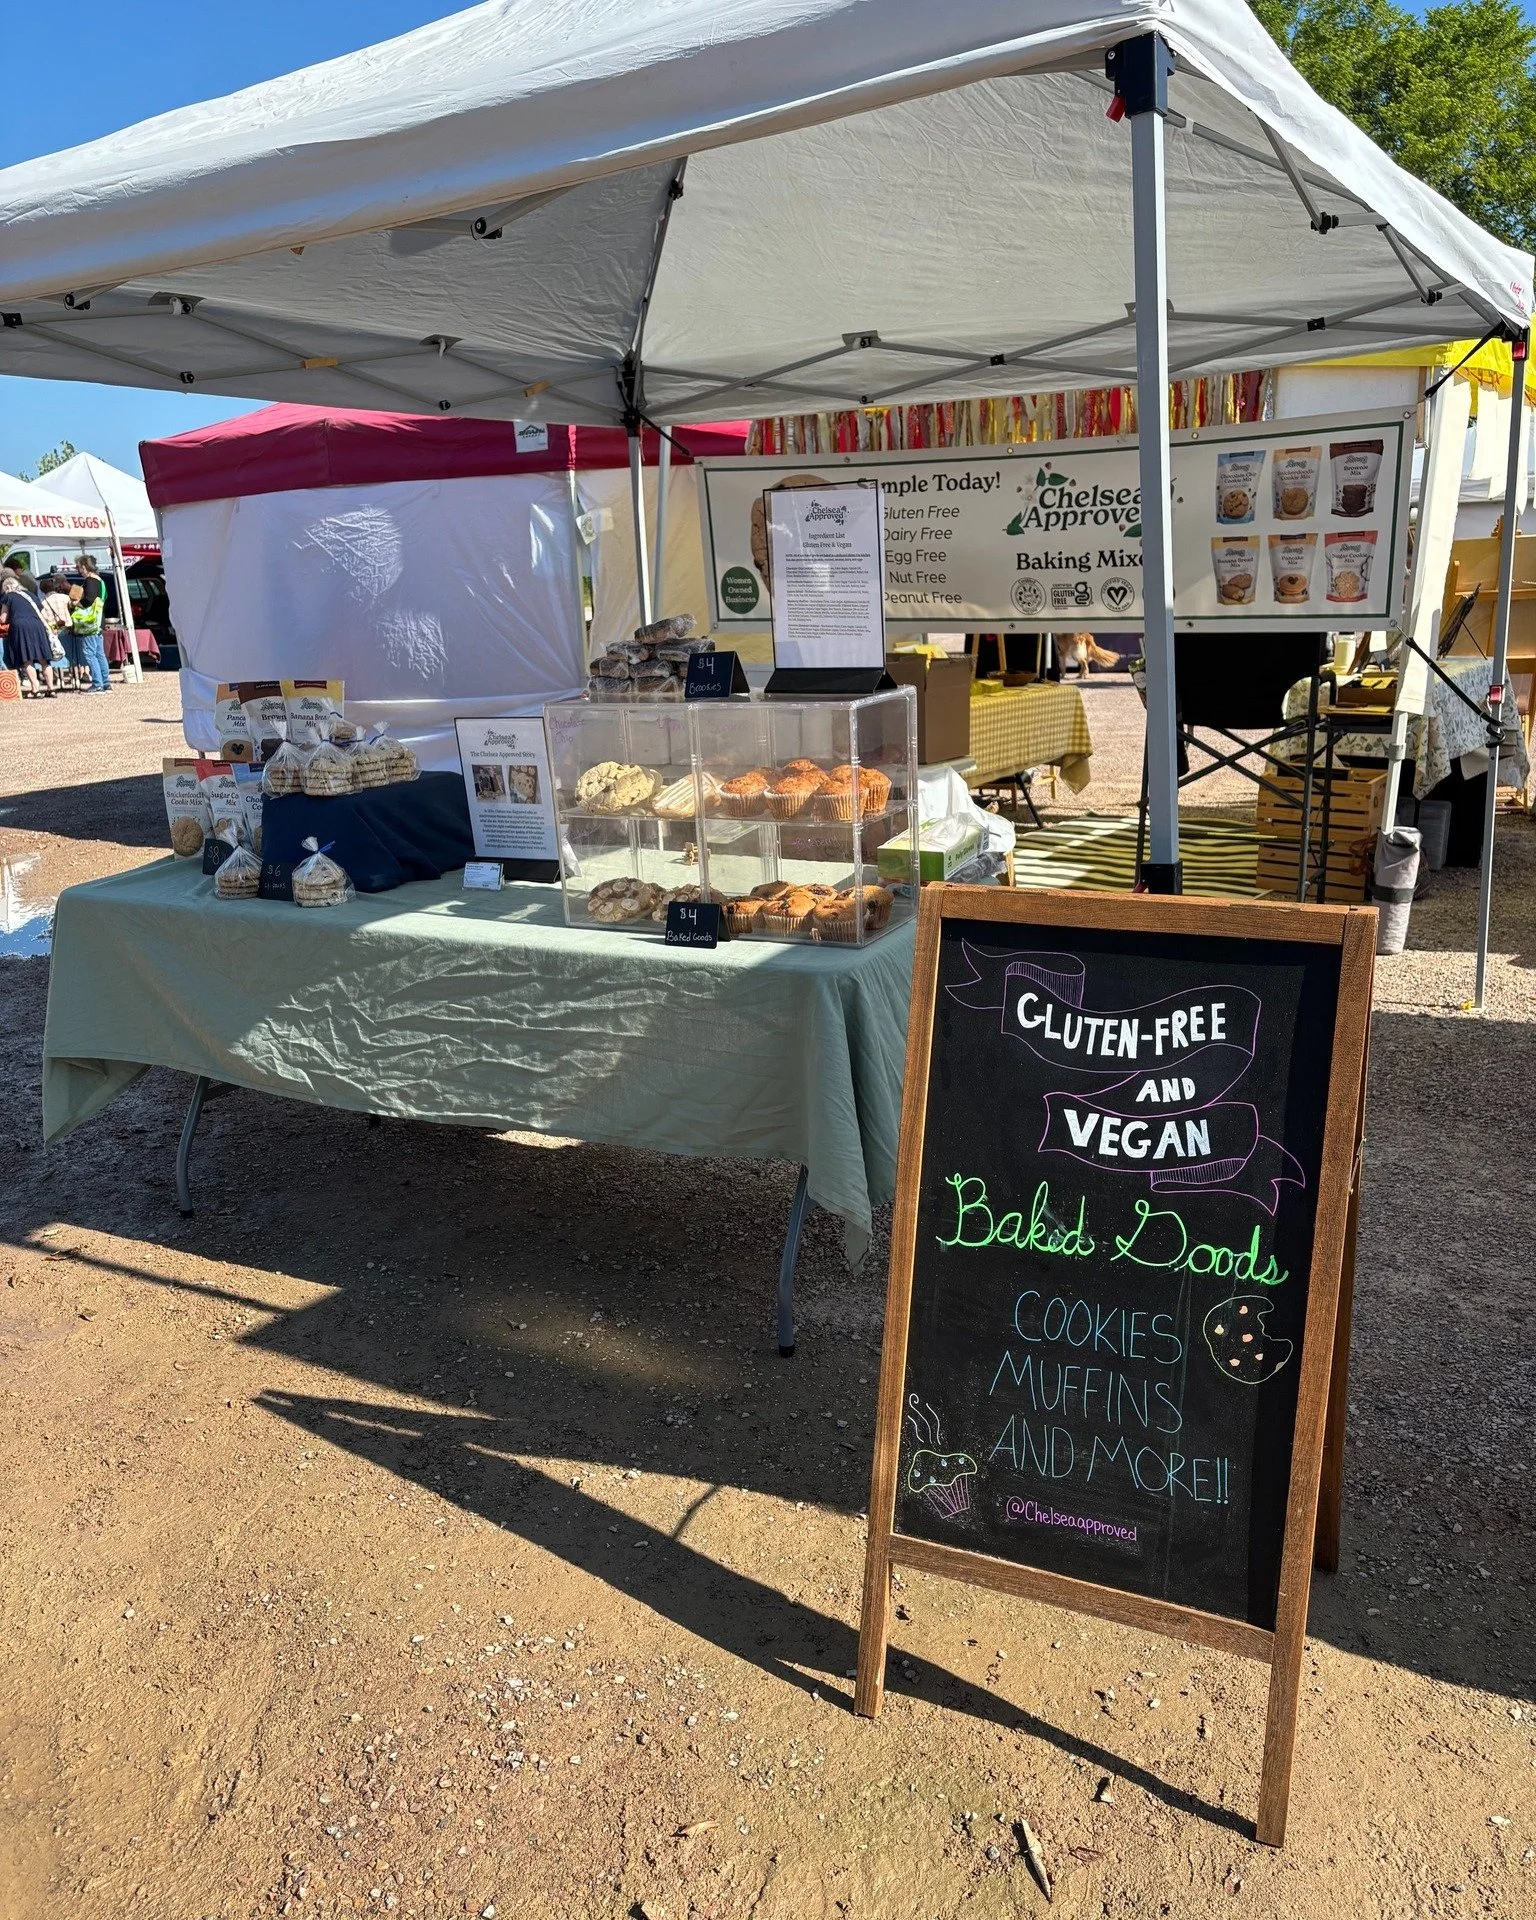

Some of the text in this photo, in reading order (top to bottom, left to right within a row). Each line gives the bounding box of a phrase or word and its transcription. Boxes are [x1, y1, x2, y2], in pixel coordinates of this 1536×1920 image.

[881, 471, 1000, 497] mple Today!
[810, 513, 844, 521] Approved
[928, 505, 960, 518] Free
[1023, 506, 1140, 532] Approve
[22, 515, 64, 528] PLANTS
[72, 516, 100, 529] EGGS
[921, 527, 953, 540] Free
[885, 550, 912, 565] Egg
[916, 549, 947, 562] Free
[1016, 551, 1091, 573] Baking
[889, 571, 947, 583] Nut Free
[931, 591, 962, 604] Free
[1053, 590, 1075, 598] GLUTEN
[697, 656, 714, 674] $4
[211, 791, 230, 800] Sugar
[207, 845, 220, 864] $8
[680, 907, 697, 925] $4
[667, 930, 713, 942] Baked Goods
[1017, 992, 1226, 1058] GLUTEN-FREE
[1136, 1077, 1195, 1103] AND
[1064, 1108, 1211, 1159] VEGAN
[936, 1173, 1289, 1285] Baked Goods
[1015, 1291, 1182, 1364] COOKIES
[990, 1350, 1182, 1433] MUFFINS
[989, 1414, 1229, 1504] AND MORE!!
[1006, 1496, 1137, 1541] @Chelseaapproved
